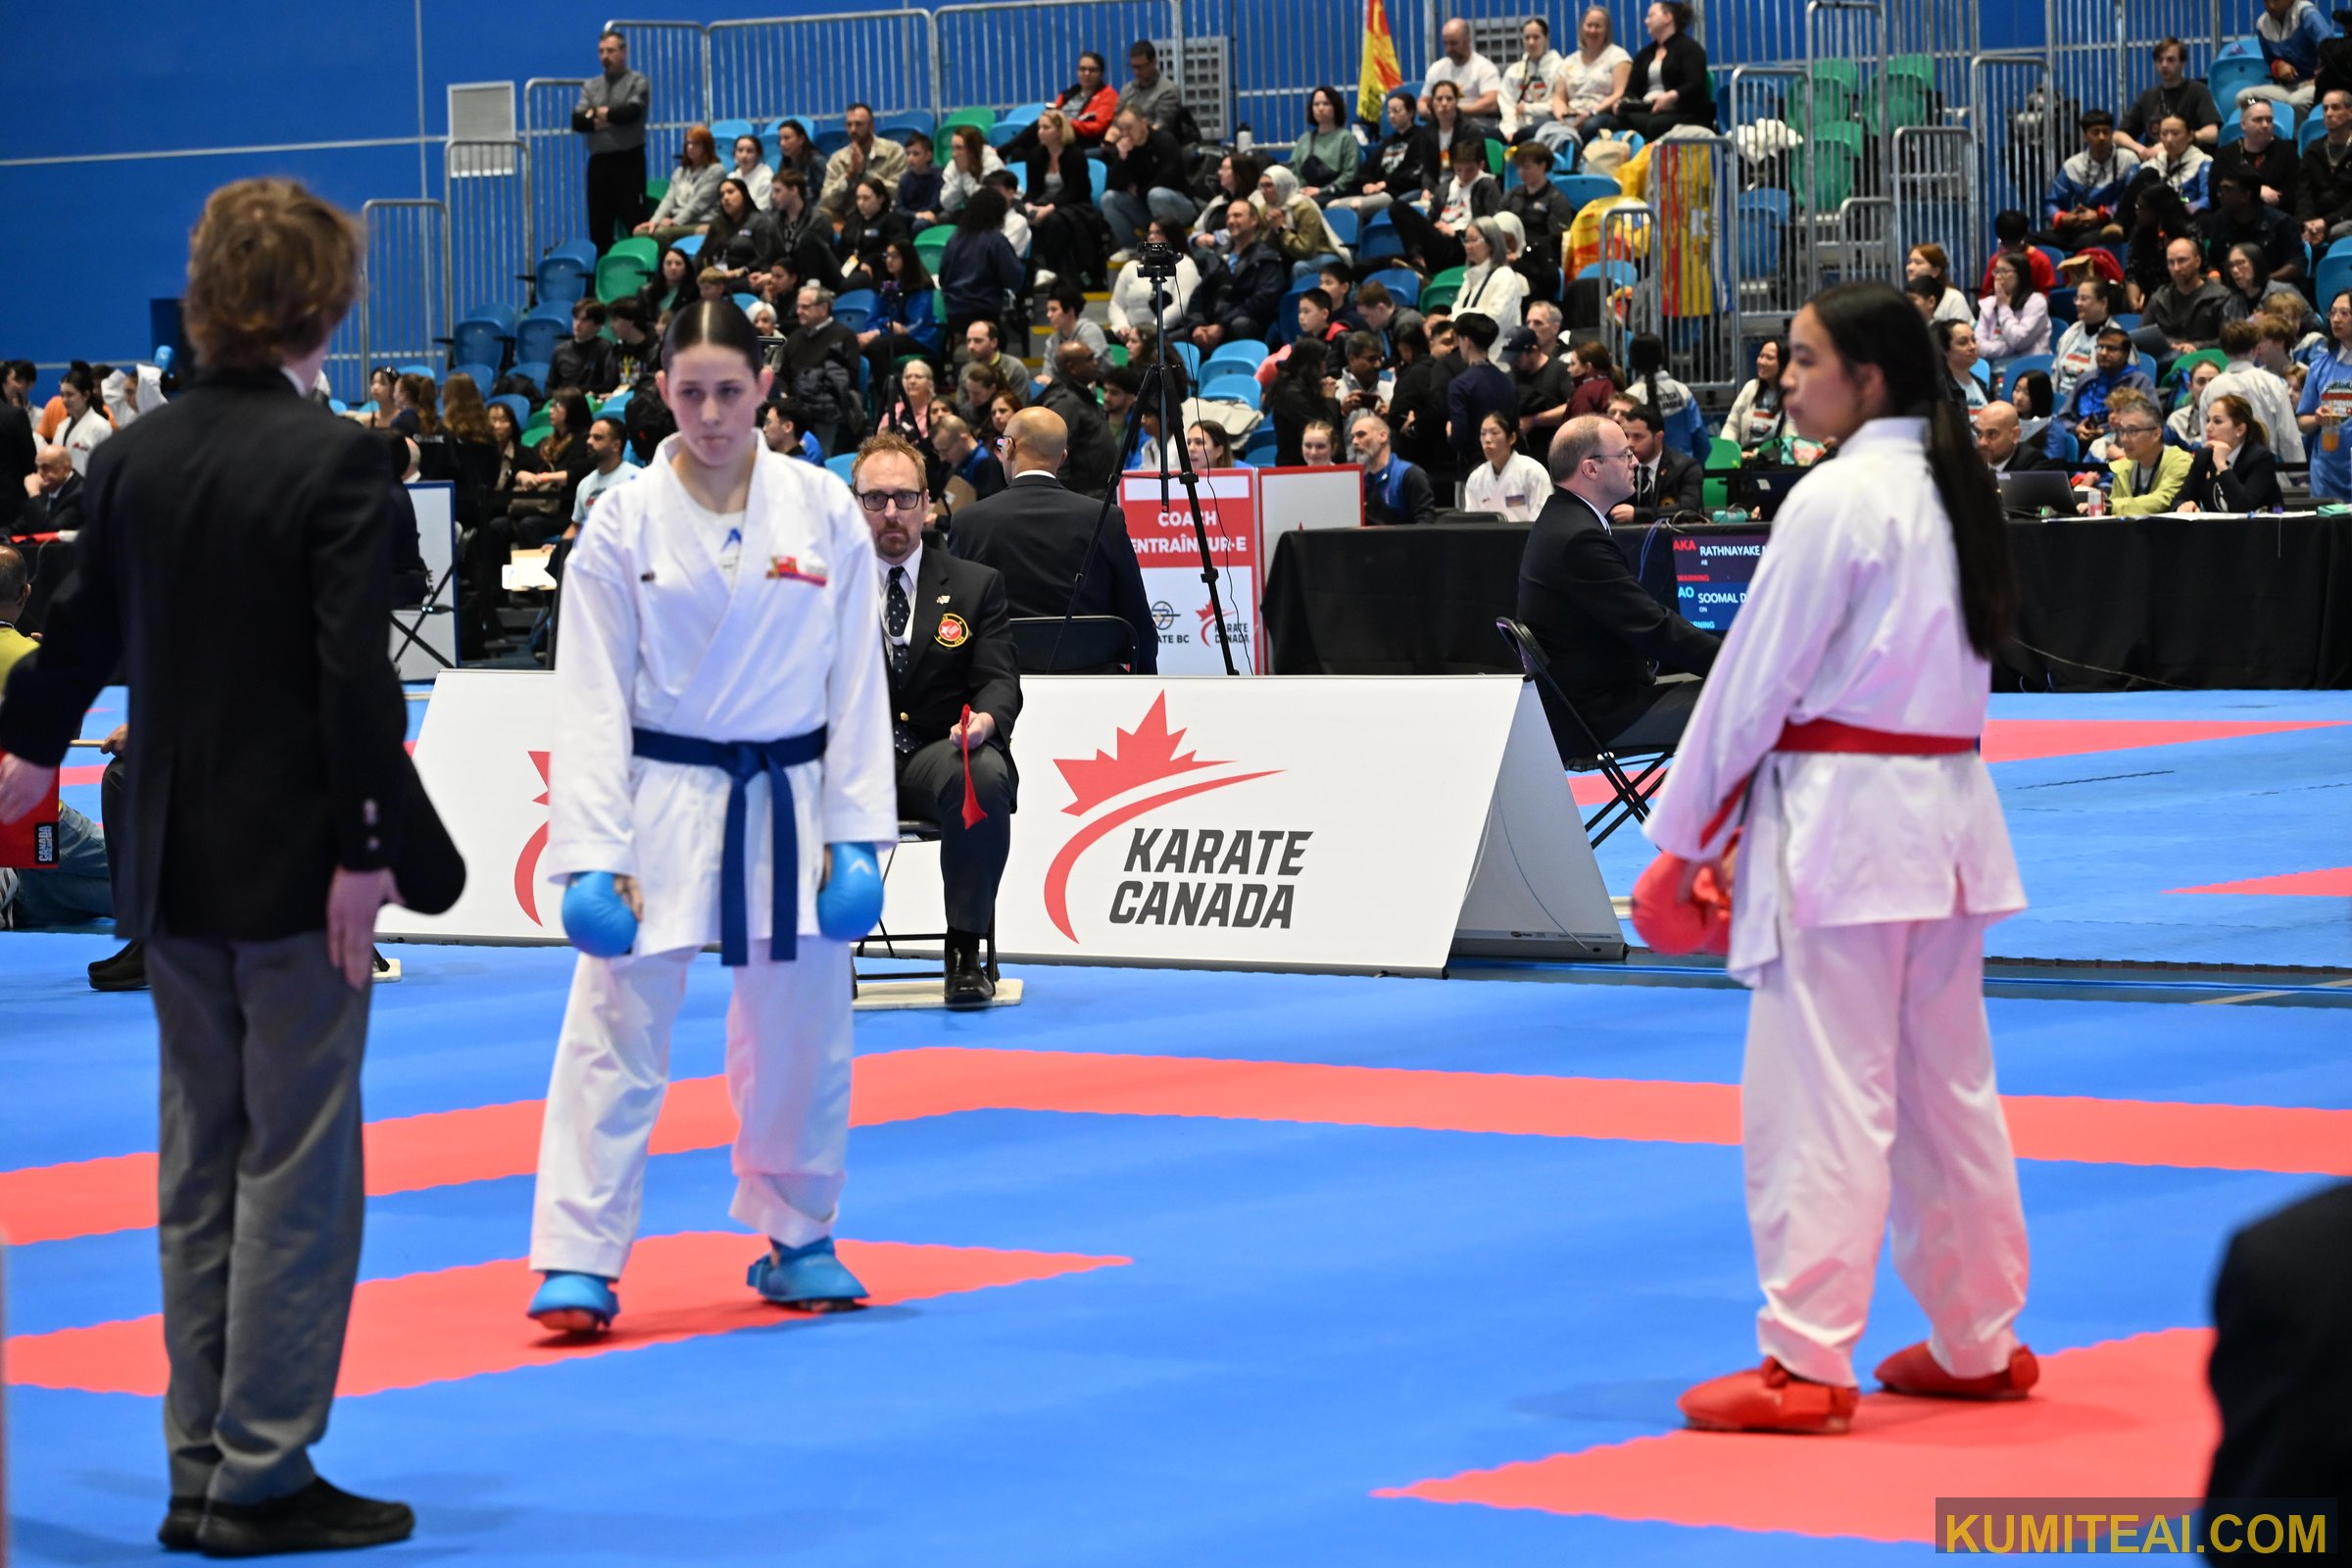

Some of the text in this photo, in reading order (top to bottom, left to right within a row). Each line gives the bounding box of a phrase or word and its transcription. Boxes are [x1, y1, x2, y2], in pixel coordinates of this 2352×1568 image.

[1157, 511, 1217, 527] COAH
[1673, 540, 1695, 551] AKA
[1699, 546, 1760, 557] RATHNAYAKE
[1678, 587, 1694, 598] AO
[1697, 593, 1738, 603] SOOMAL
[1214, 623, 1249, 633] RATE
[1176, 634, 1190, 644] BC
[1214, 634, 1250, 644] CNADA
[1123, 827, 1314, 876] KARATE
[1108, 880, 1295, 929] CANADA
